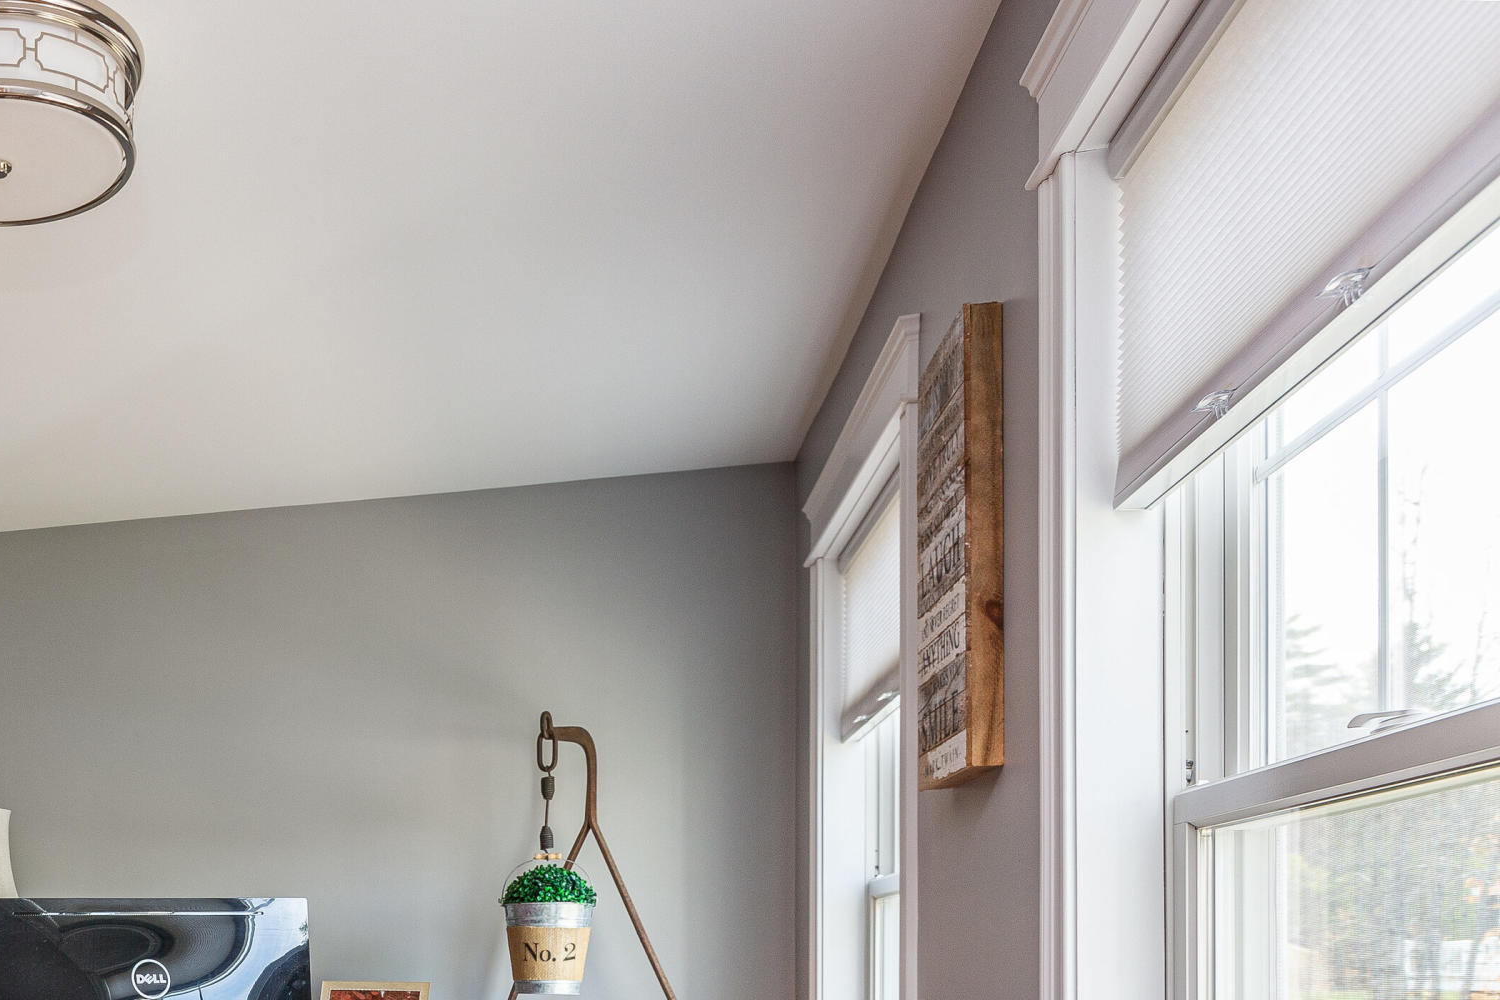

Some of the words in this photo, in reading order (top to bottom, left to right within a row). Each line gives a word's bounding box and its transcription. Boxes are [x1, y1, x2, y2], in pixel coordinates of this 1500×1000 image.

[921, 523, 960, 599] LAUGH
[921, 621, 960, 677] ANYTHING
[921, 689, 959, 752] SMILE
[136, 973, 166, 984] DELL
[523, 943, 556, 962] No.
[563, 943, 576, 962] 2
